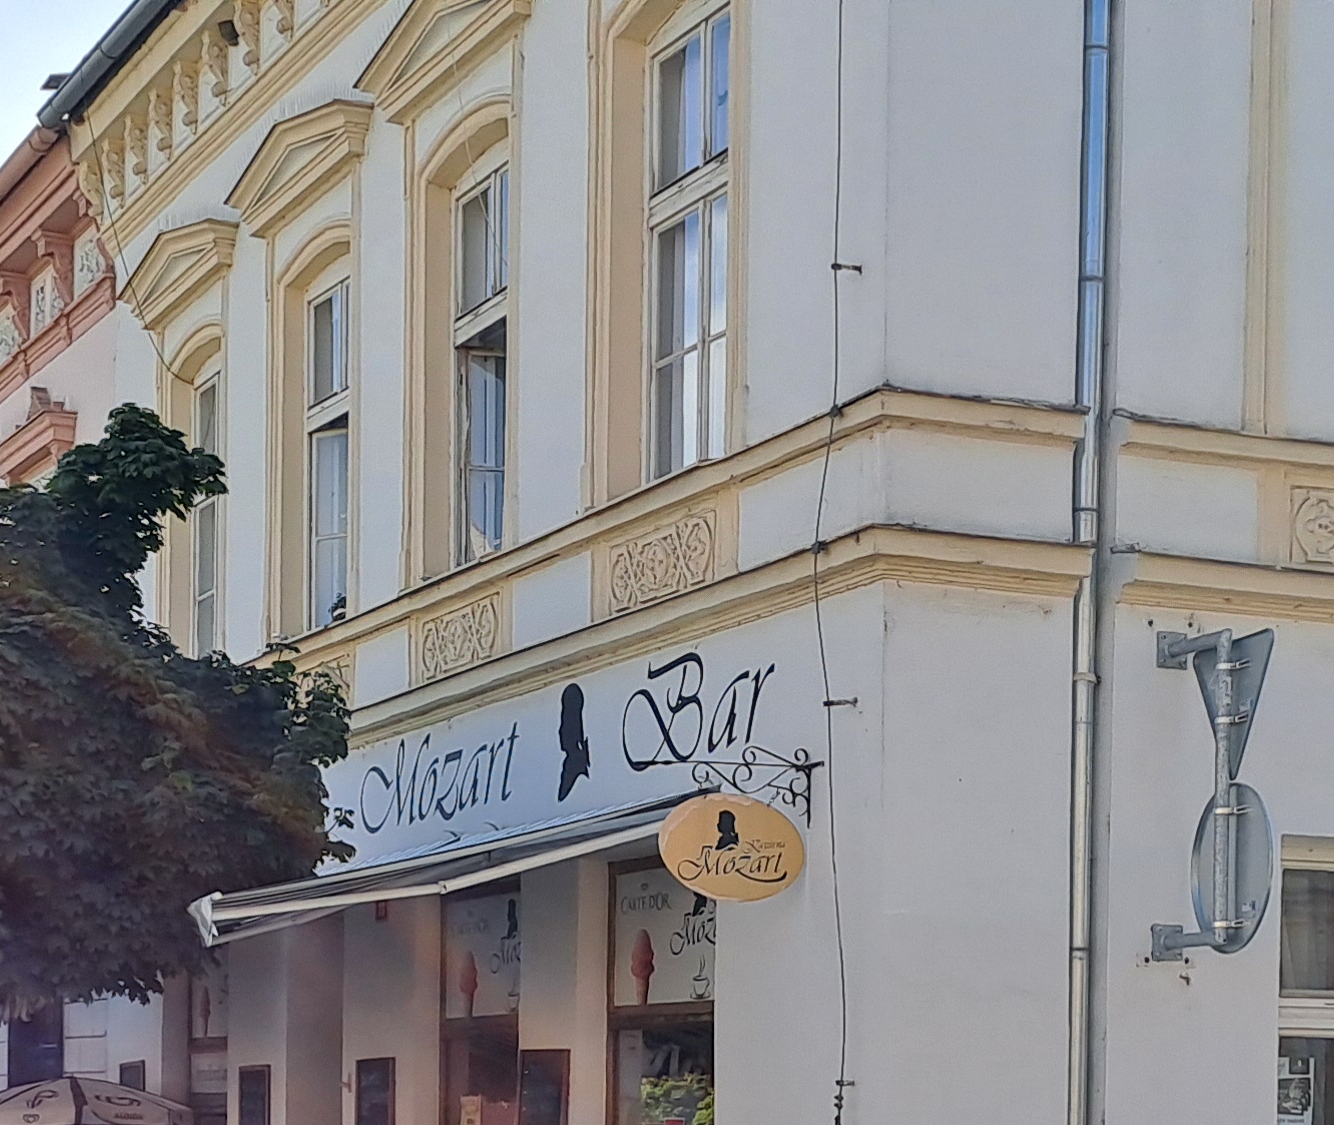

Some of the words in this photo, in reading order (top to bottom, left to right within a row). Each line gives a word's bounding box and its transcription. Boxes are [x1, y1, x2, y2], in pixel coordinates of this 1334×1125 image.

[360, 721, 520, 834] Mozart
[622, 652, 775, 772] Bar
[677, 845, 788, 883] Mozart
